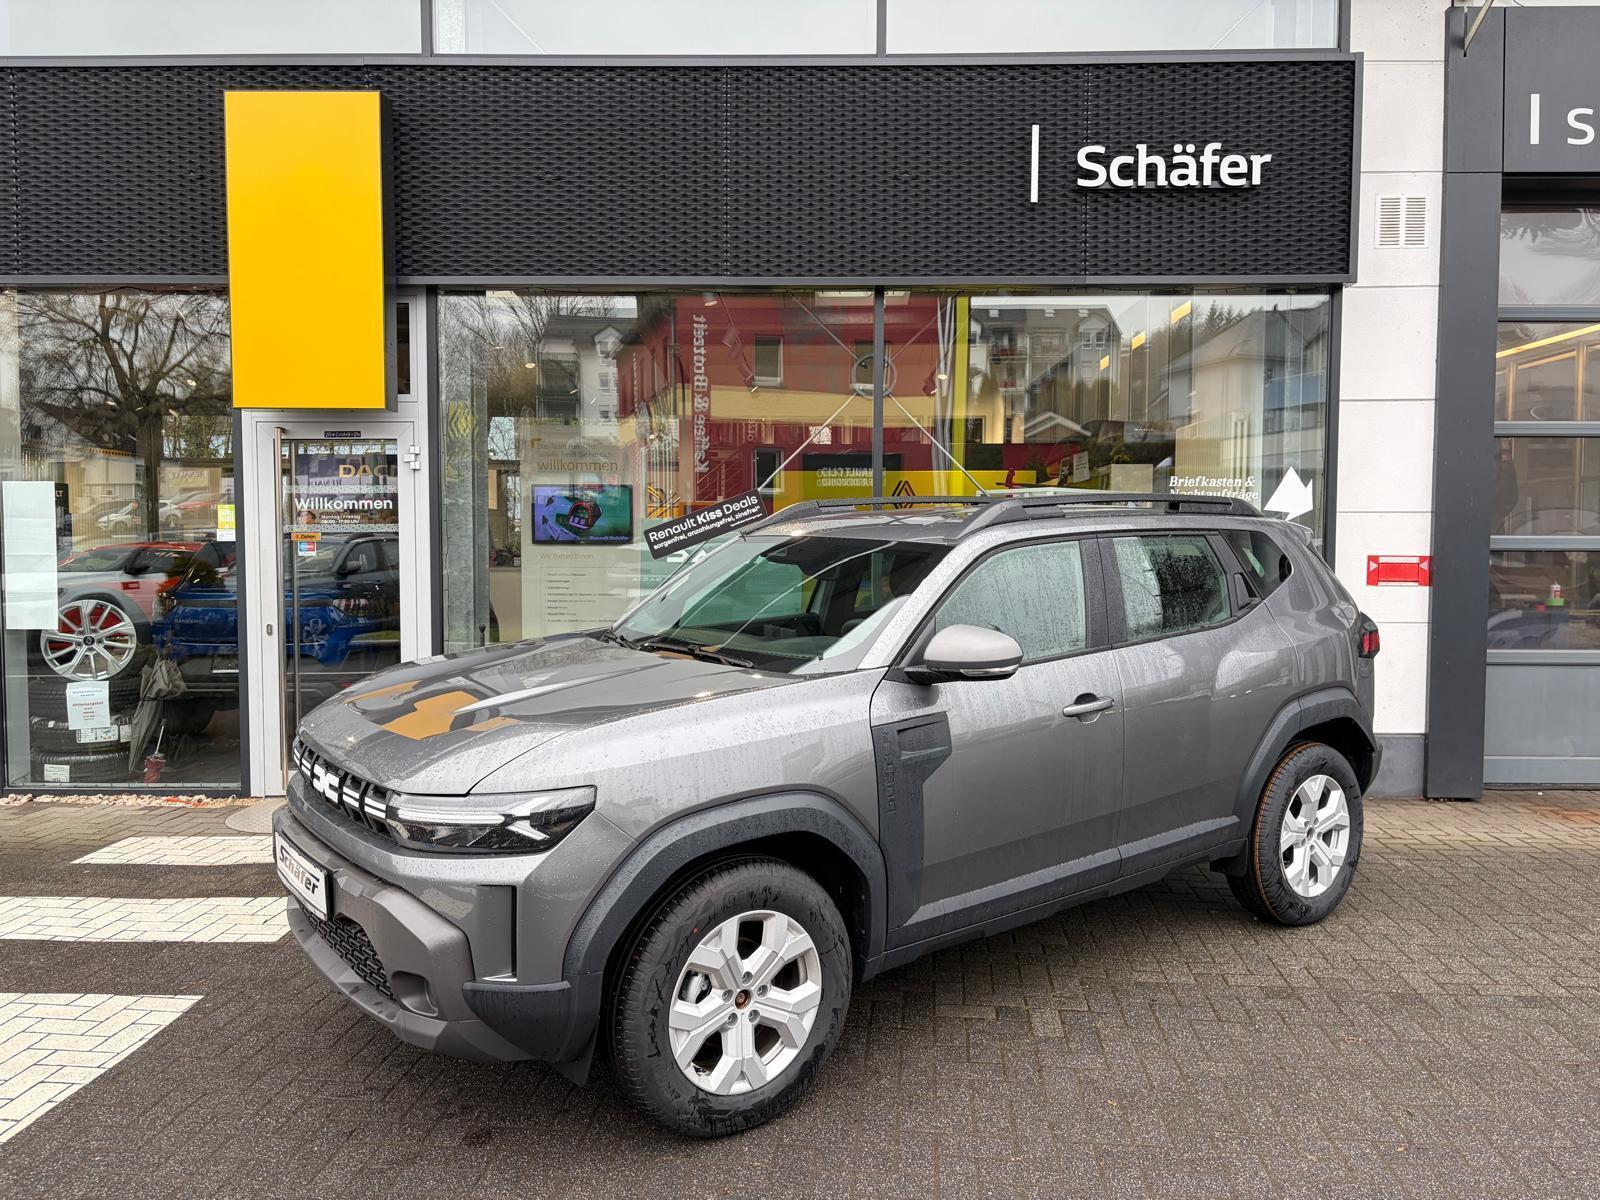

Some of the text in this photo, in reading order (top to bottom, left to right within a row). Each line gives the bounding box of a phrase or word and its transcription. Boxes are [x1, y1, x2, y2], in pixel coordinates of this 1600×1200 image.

[1076, 142, 1273, 187] Schäfer
[1168, 475, 1256, 488] Briefkasten &
[293, 497, 394, 510] Willkommen
[648, 518, 697, 543] Renault
[696, 507, 723, 525] Kiss
[722, 494, 759, 515] Deals
[652, 533, 688, 550] sorgenfrei,
[686, 516, 736, 538] anzahlungsfrei,
[279, 845, 320, 895] Schäfer
